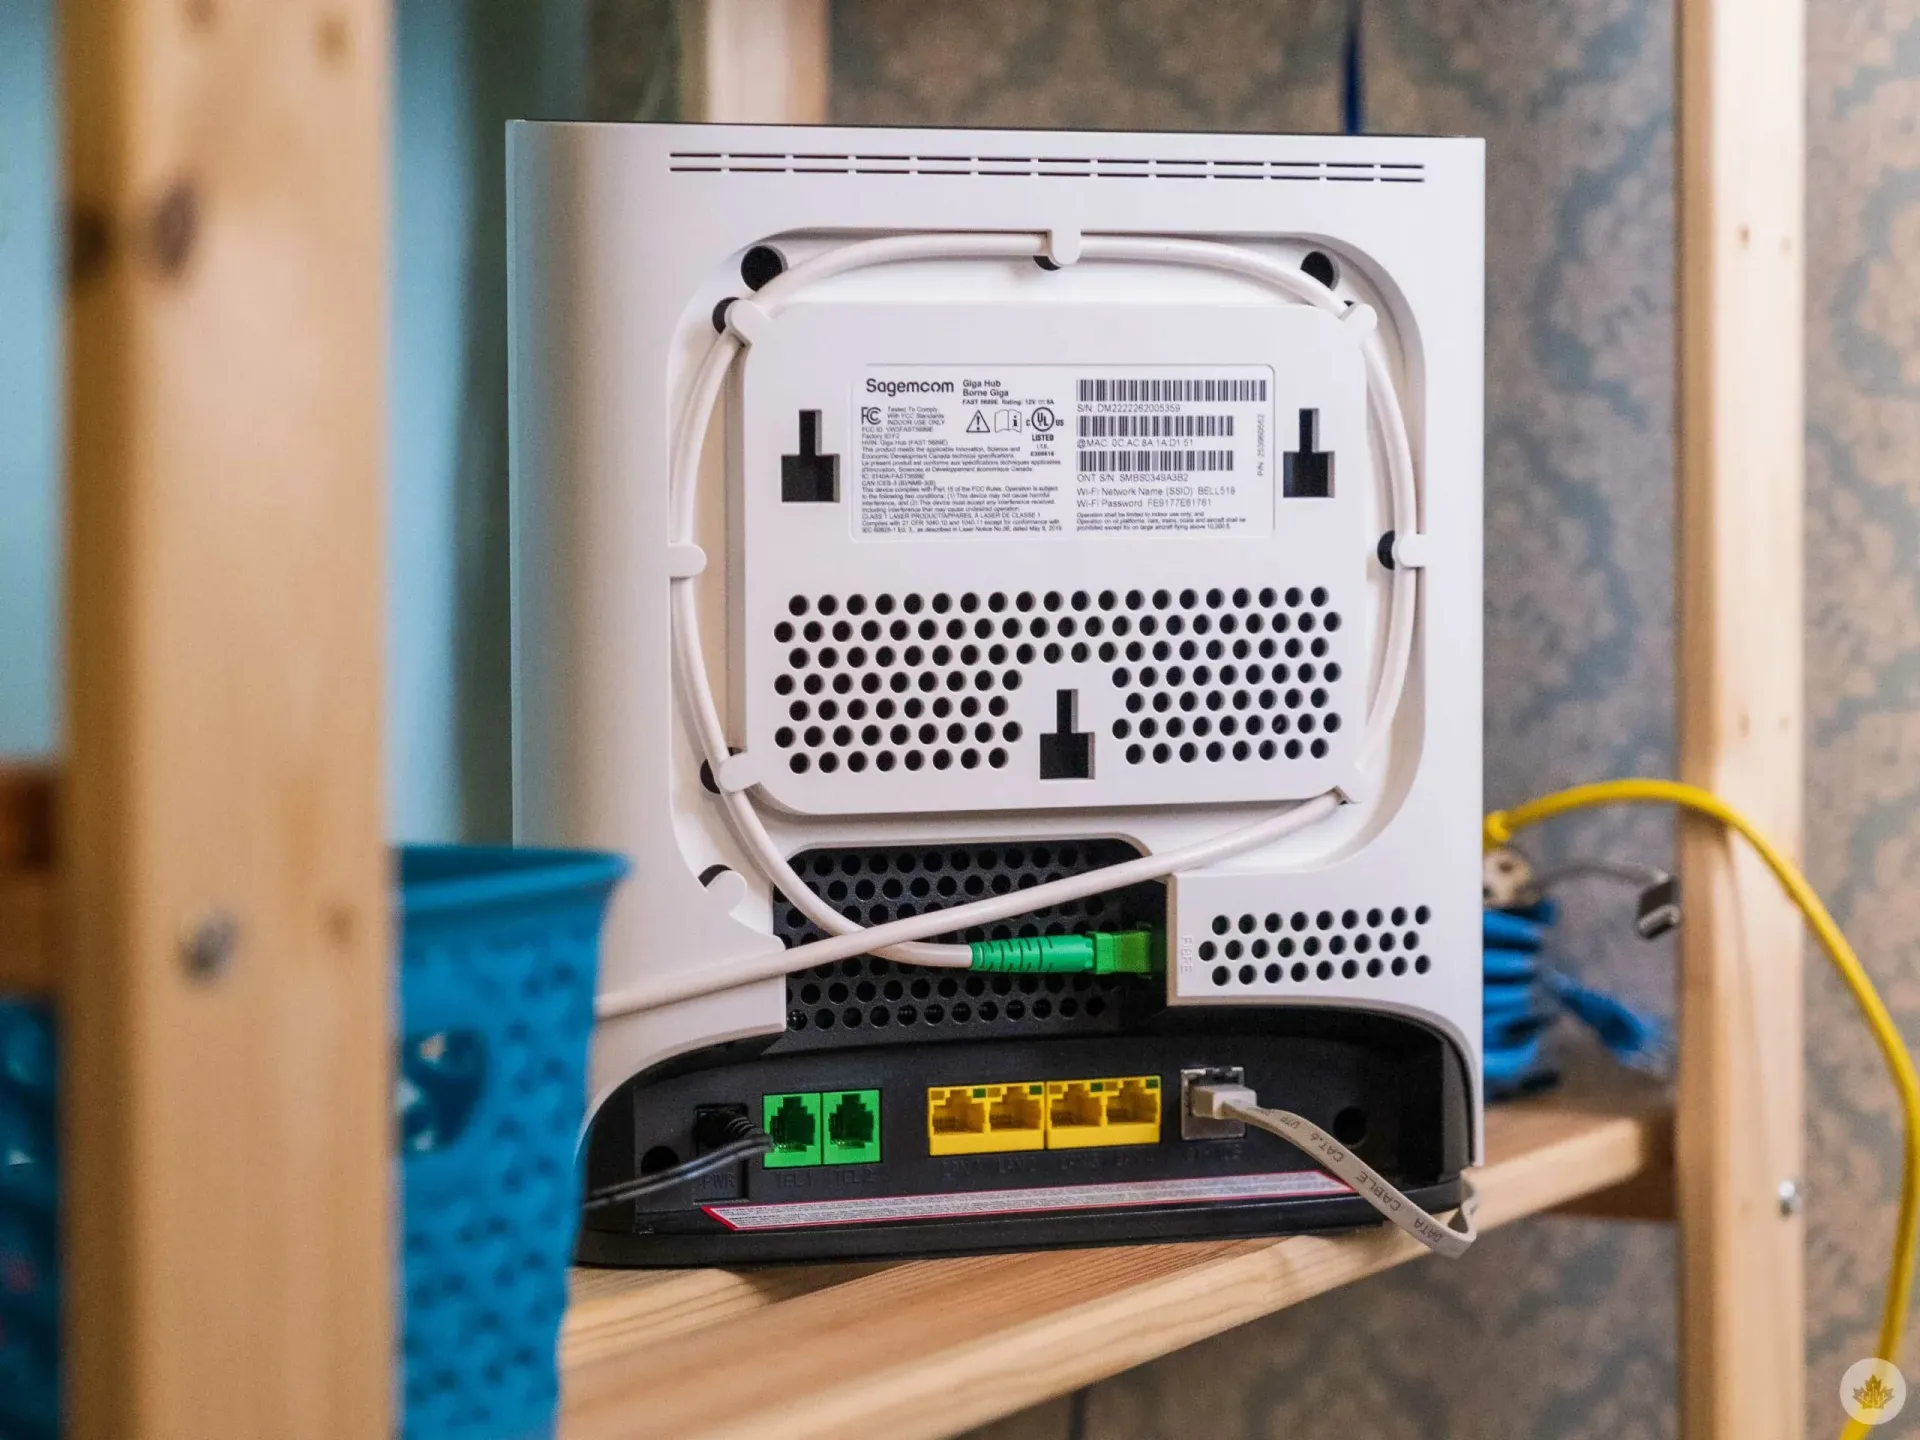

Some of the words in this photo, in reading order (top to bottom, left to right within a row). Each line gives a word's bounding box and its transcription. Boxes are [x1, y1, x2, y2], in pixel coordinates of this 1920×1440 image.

[866, 378, 954, 397] Sagemcom
[962, 379, 982, 389] Giga
[984, 379, 1001, 388] Hub
[962, 388, 988, 397] Borne
[990, 388, 1009, 398] Giga
[1077, 474, 1096, 482] ONT
[1077, 487, 1100, 496] Wi-Fi
[1102, 487, 1136, 496] Network
[1138, 487, 1163, 496] Name
[1077, 499, 1100, 508] Wi-Fi
[702, 1171, 736, 1190] PWR
[775, 1171, 802, 1188] TEL
[835, 1168, 860, 1185] TEL
[1355, 1170, 1401, 1211] CABLE
[1414, 1218, 1443, 1243] DATA
